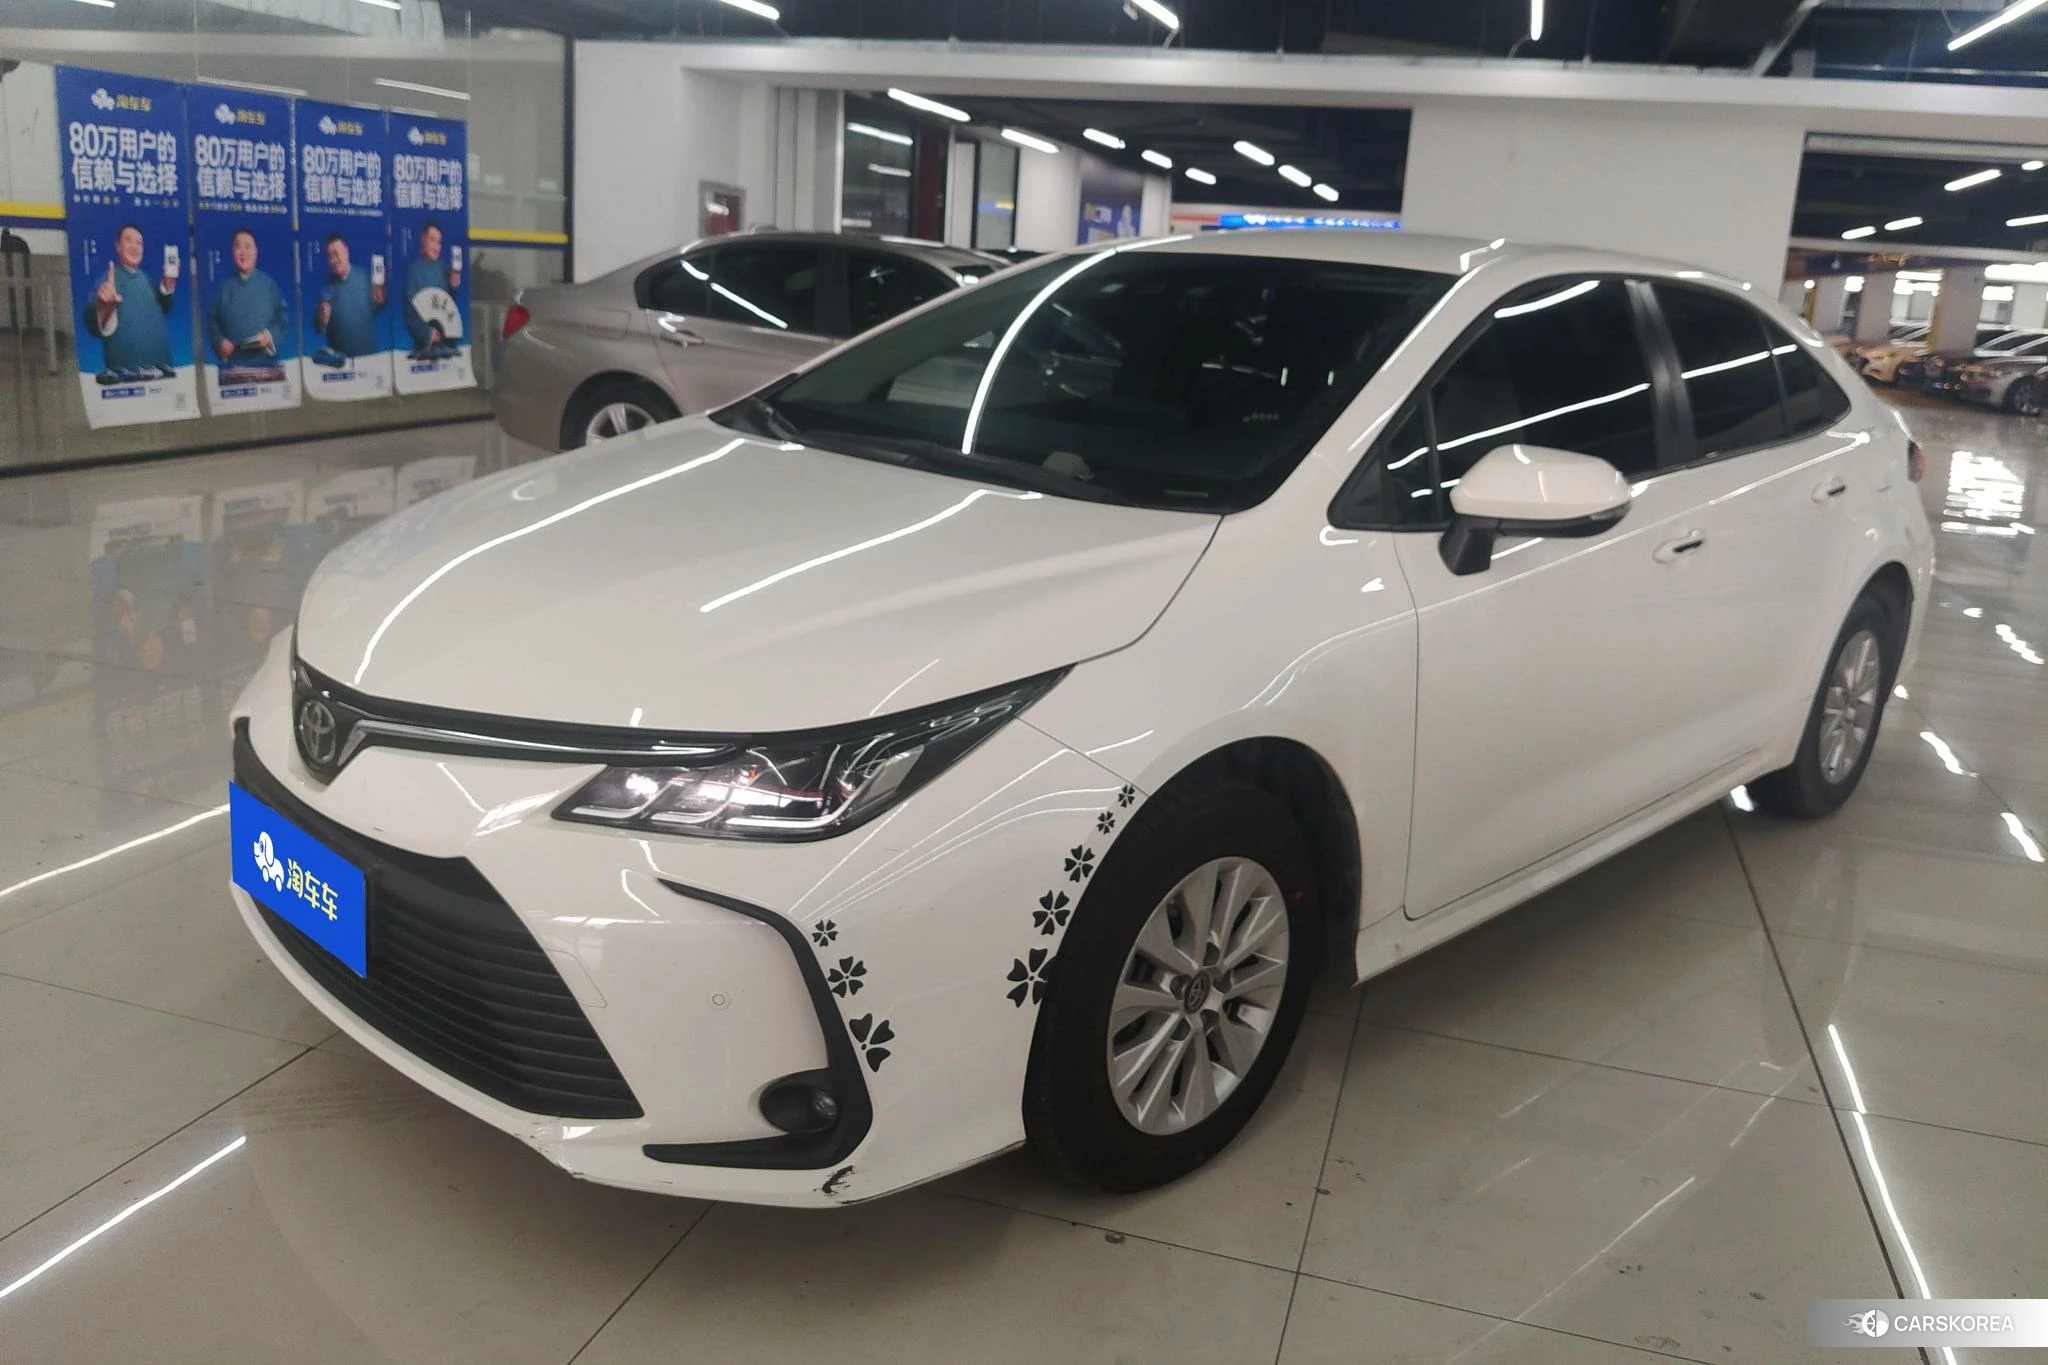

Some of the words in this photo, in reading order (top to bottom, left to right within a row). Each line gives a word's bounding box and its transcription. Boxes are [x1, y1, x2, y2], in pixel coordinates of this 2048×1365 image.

[69, 121, 176, 162] 80万用户的
[195, 134, 285, 171] 80万用户的
[72, 157, 178, 196] 信赖与选择
[303, 144, 381, 178] 80万用户的
[394, 153, 462, 185] 80万用户的
[197, 166, 287, 202] 信赖与选择
[304, 174, 382, 206] 信赖与选择
[395, 182, 462, 211] 信赖与选择
